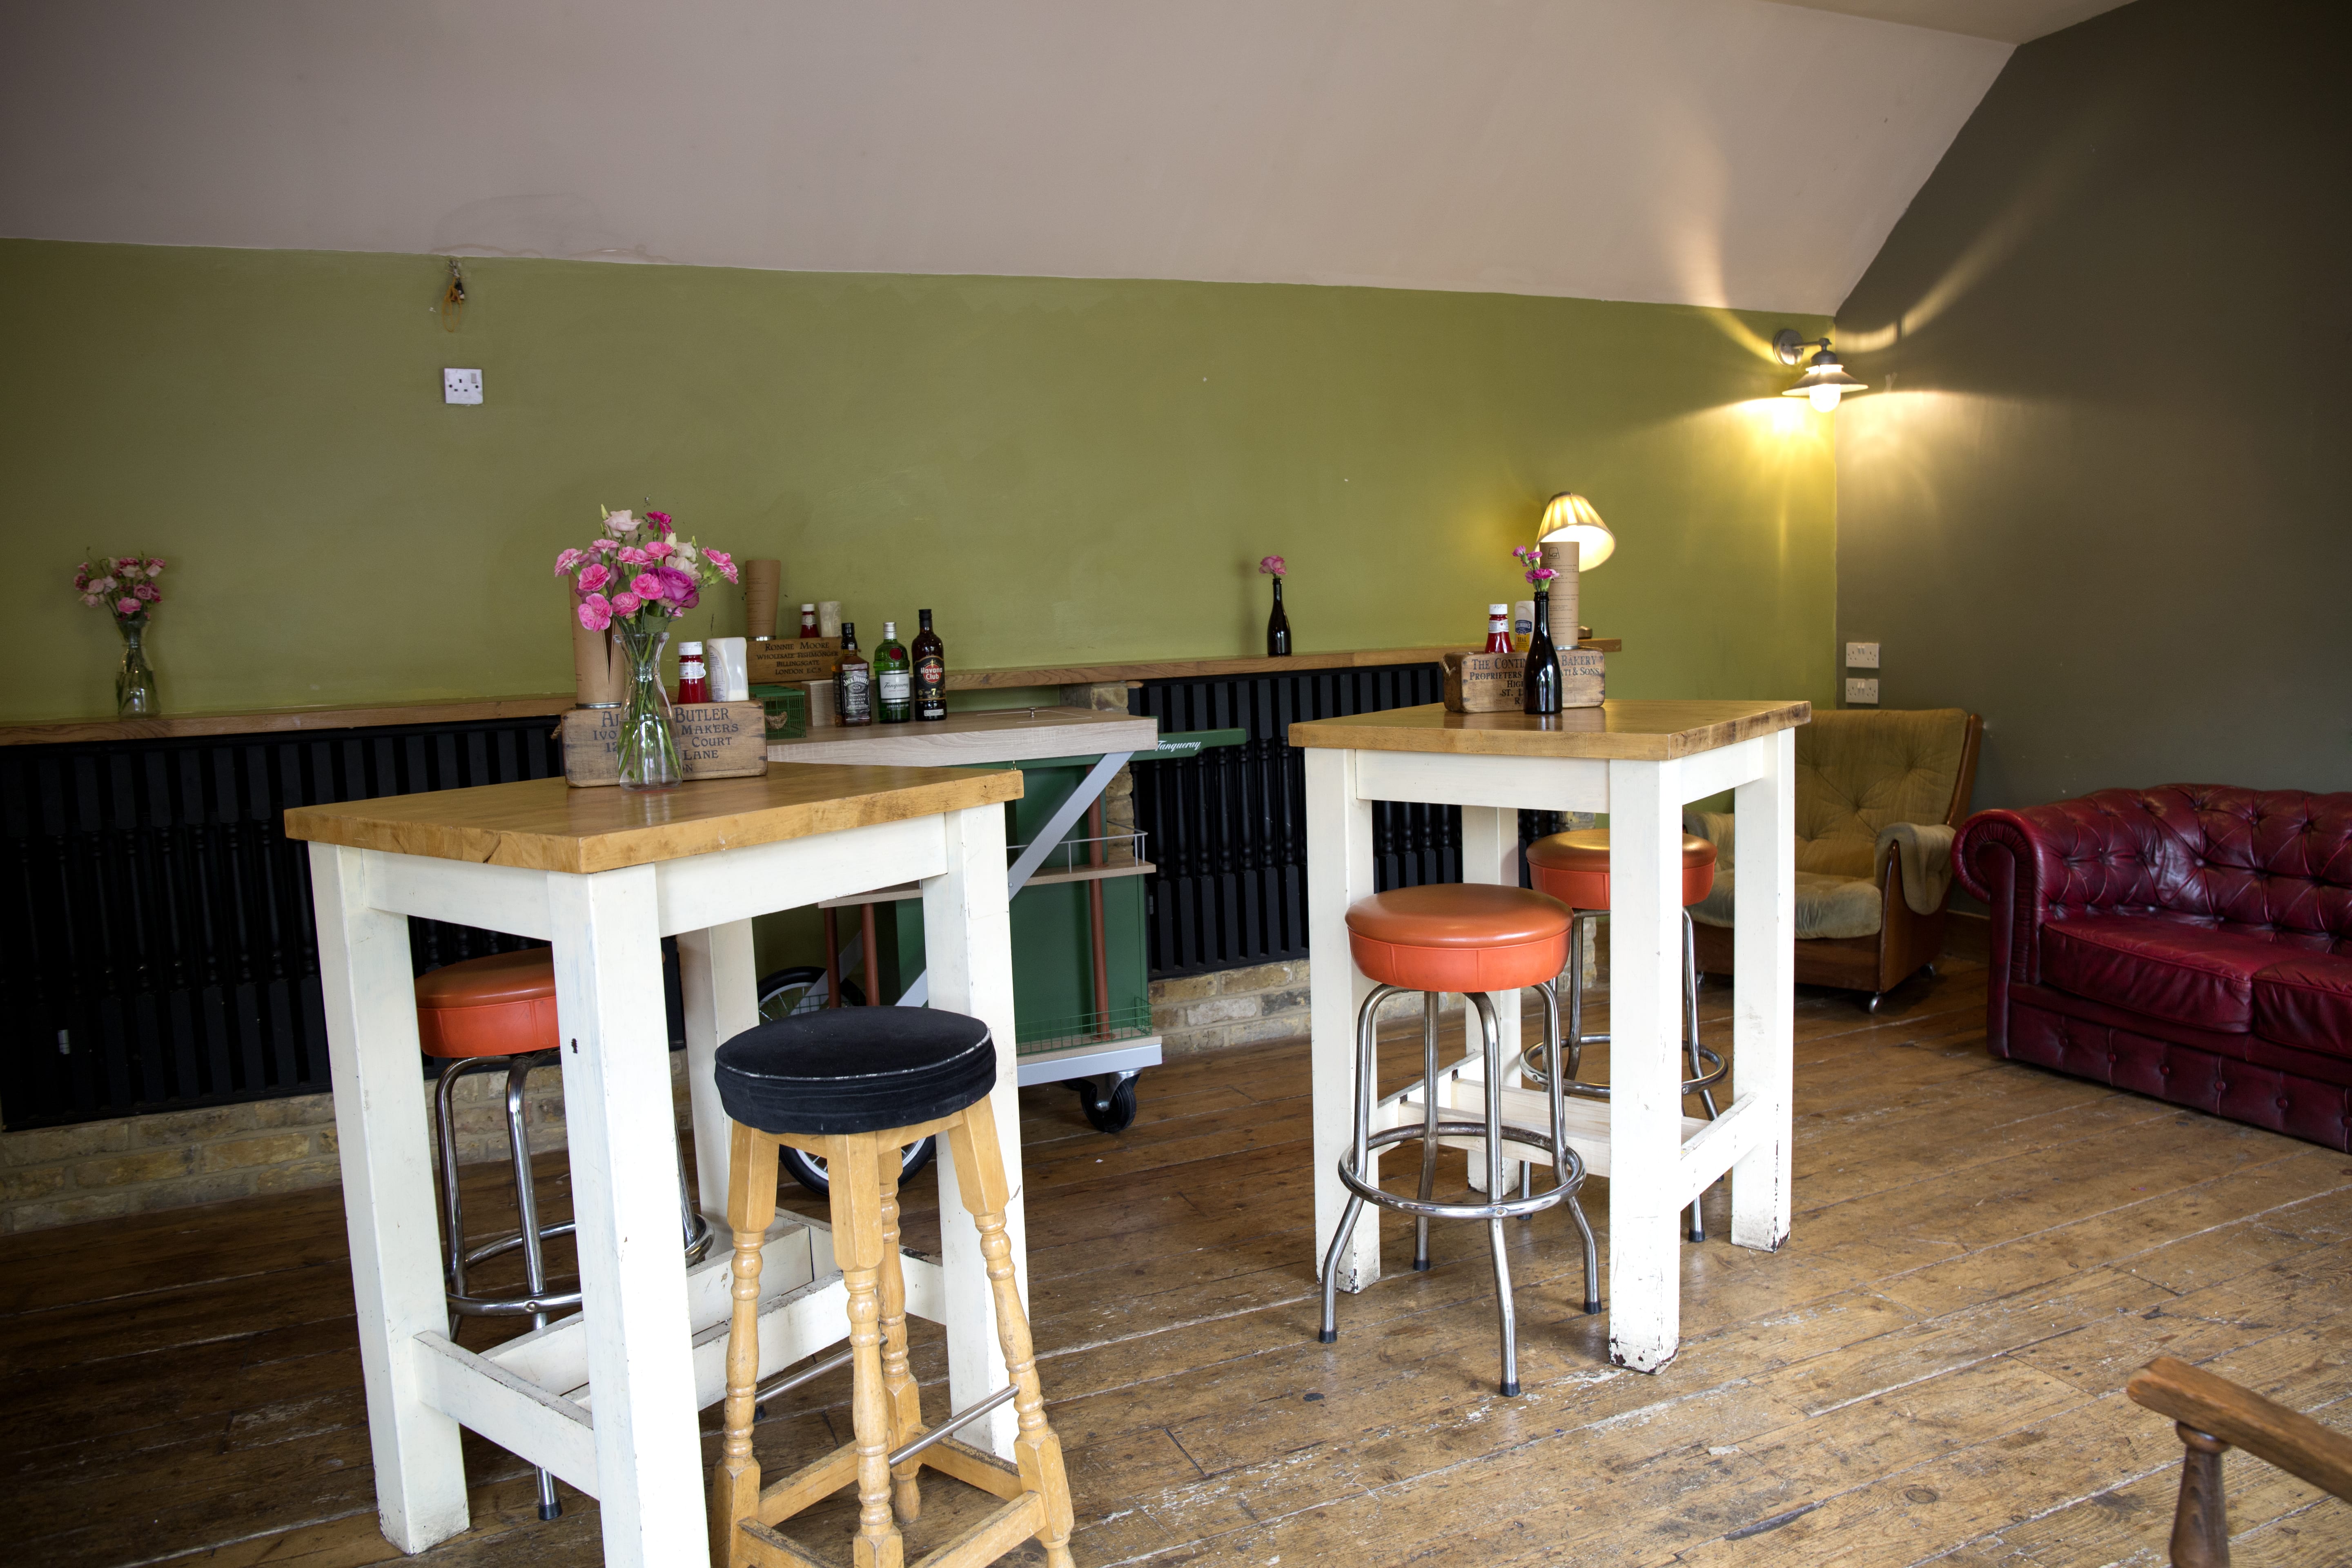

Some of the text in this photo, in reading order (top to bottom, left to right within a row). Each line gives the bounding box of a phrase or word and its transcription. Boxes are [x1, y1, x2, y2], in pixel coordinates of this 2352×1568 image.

[1472, 659, 1490, 670] THE
[1561, 655, 1596, 666] BAKERY
[1470, 671, 1522, 680] PROPRIETERS
[1573, 667, 1578, 676] &
[843, 675, 869, 686] JACK DANIEL'S
[674, 707, 730, 723] BUTLER
[593, 730, 617, 740] IVO
[692, 737, 732, 747] COURT
[1155, 740, 1201, 752] Tanqueray
[683, 750, 719, 760] LANE
